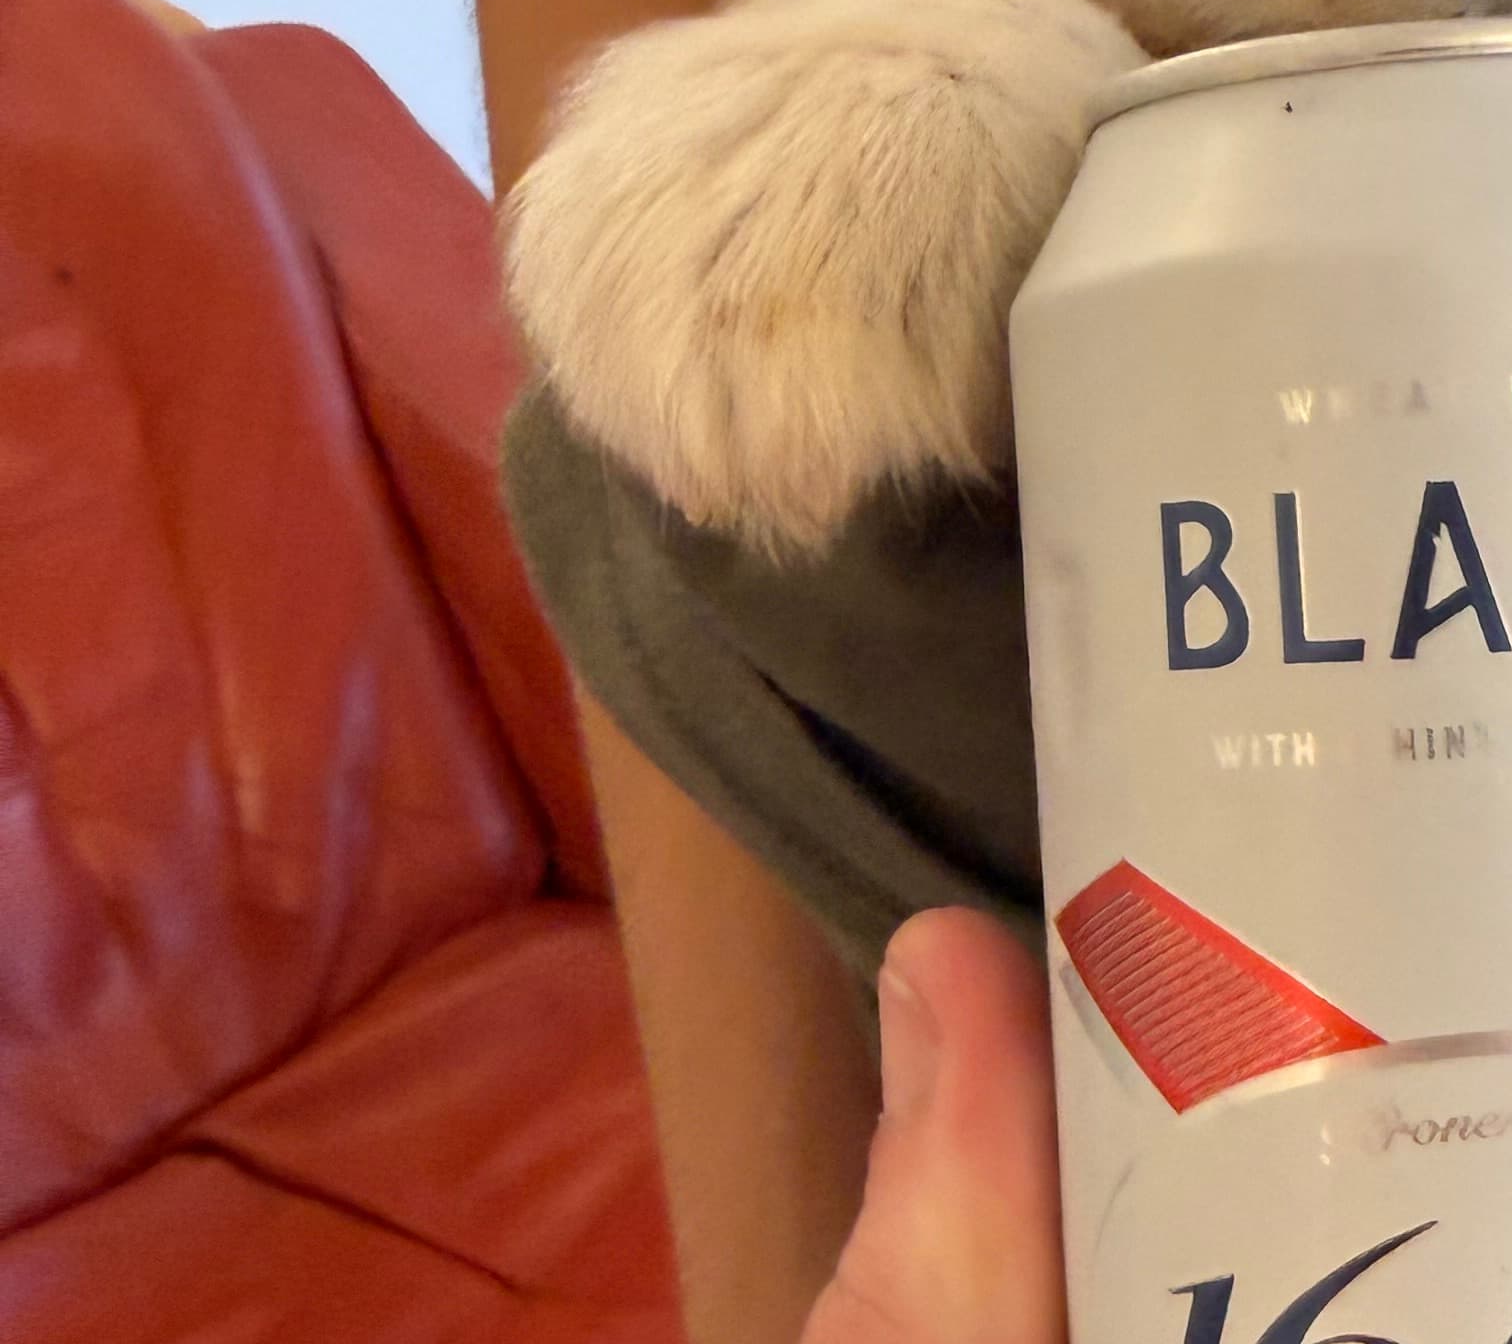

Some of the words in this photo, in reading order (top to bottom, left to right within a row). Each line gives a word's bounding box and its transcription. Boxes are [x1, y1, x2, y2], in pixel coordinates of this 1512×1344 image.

[1278, 378, 1442, 425] WEA
[1211, 731, 1317, 769] WITH
[1393, 722, 1487, 761] HIN
